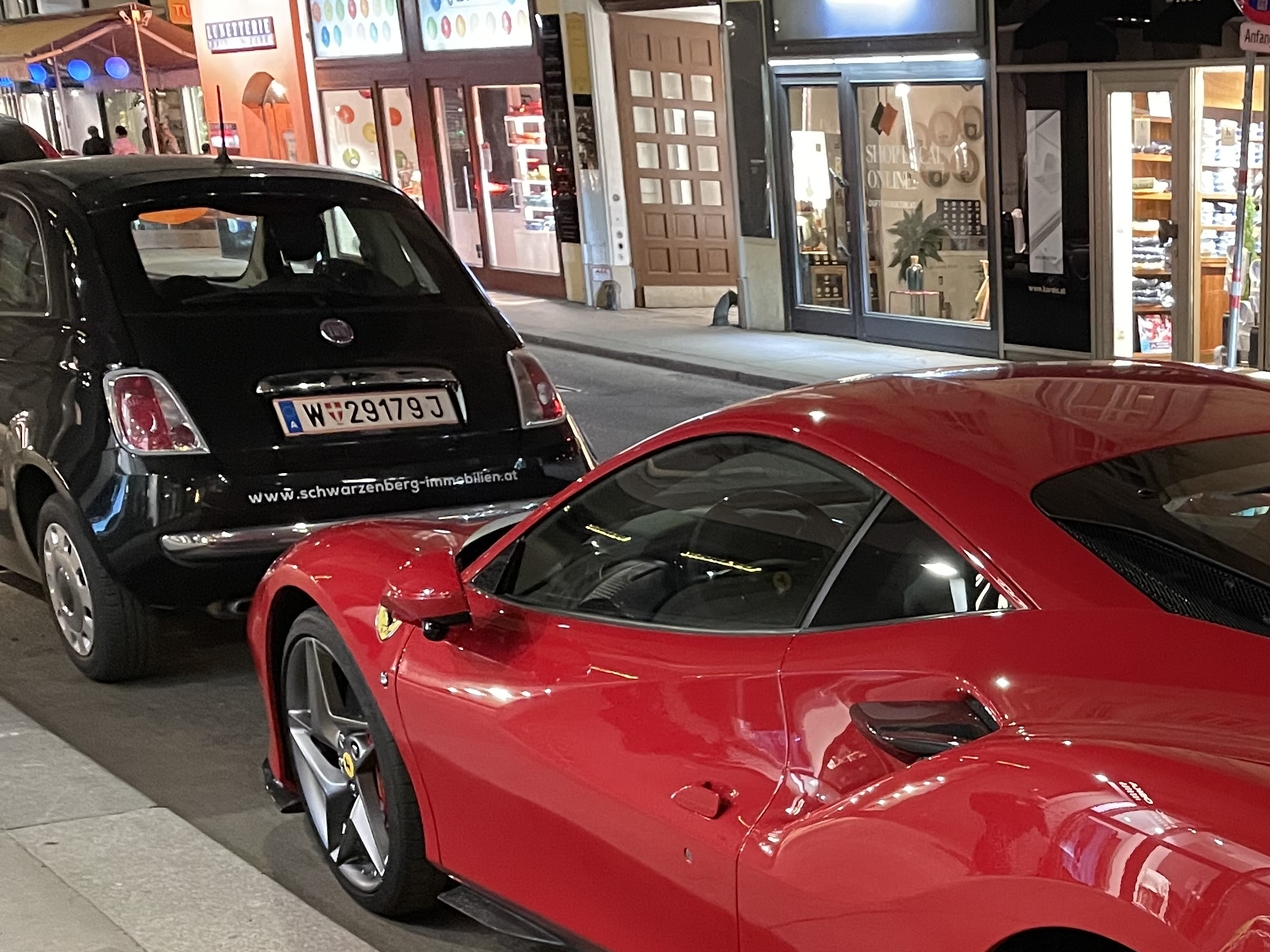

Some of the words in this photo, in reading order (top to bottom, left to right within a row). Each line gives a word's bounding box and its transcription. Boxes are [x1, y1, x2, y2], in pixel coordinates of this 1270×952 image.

[302, 402, 326, 427] W
[344, 396, 424, 423] 29179
[248, 470, 518, 504] www.schwarzenberg-immobilien.at
